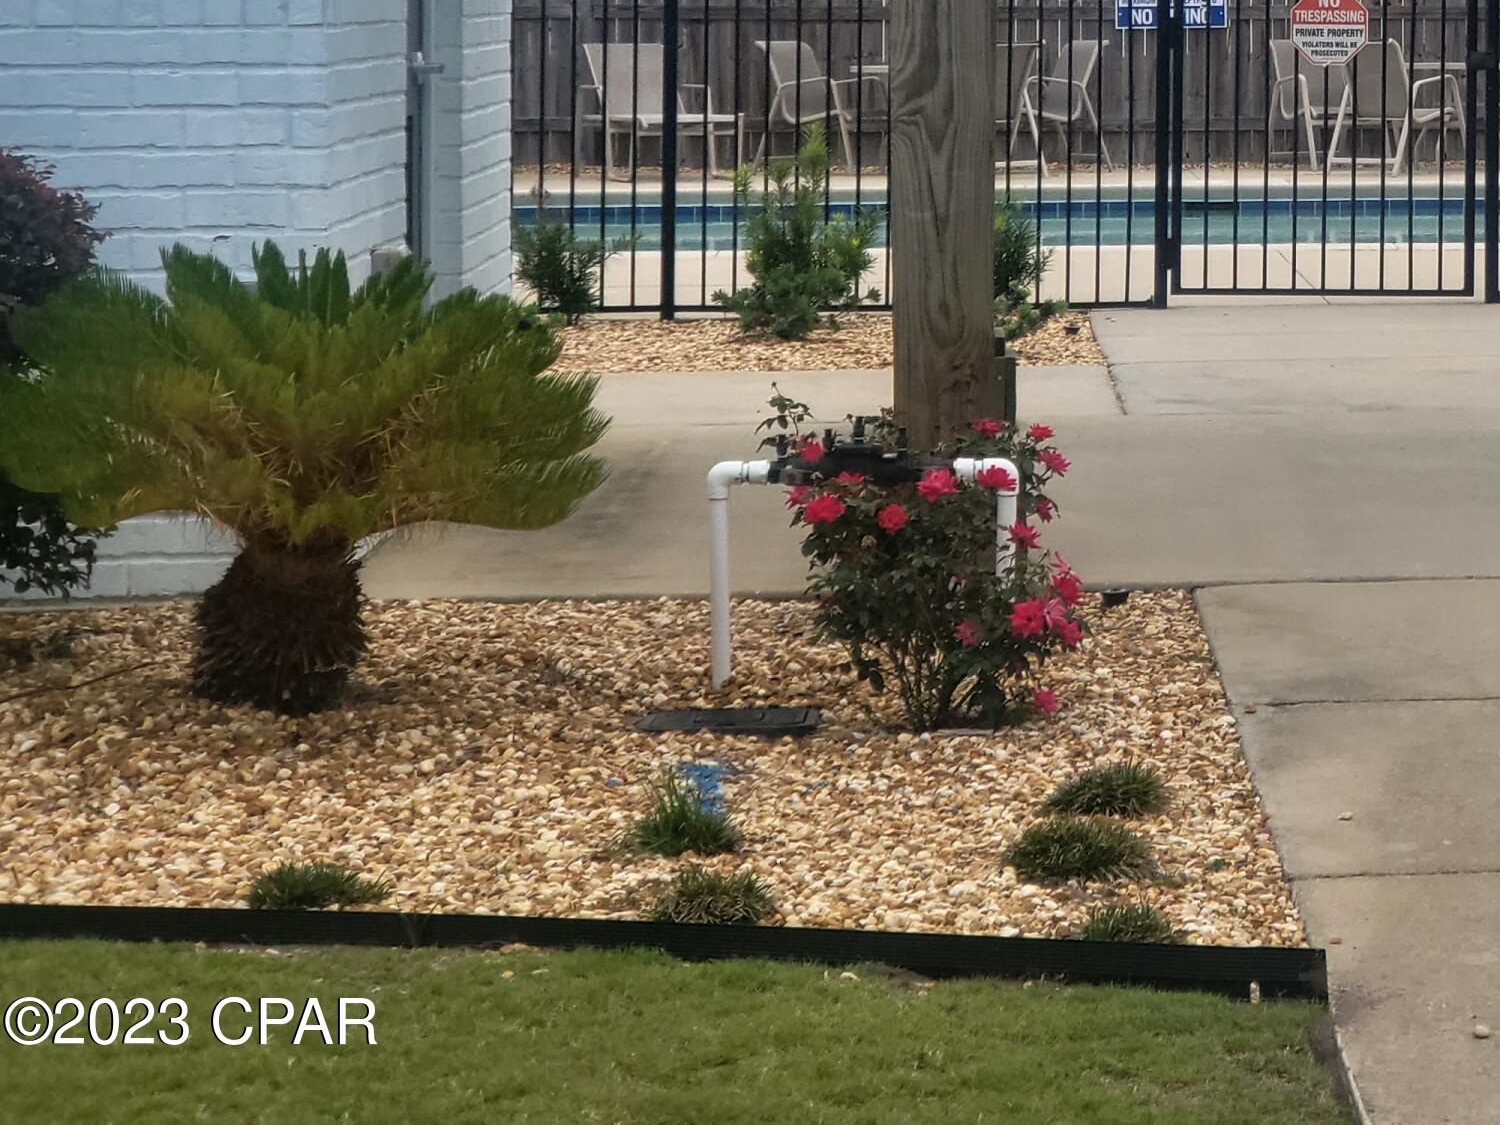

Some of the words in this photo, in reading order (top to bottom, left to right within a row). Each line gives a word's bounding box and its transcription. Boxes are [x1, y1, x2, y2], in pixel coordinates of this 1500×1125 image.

[1132, 8, 1152, 24] NO
[1294, 10, 1364, 23] TRESPASSING
[1296, 28, 1324, 38] PRIVATE
[1327, 28, 1364, 38] PROPERTY
